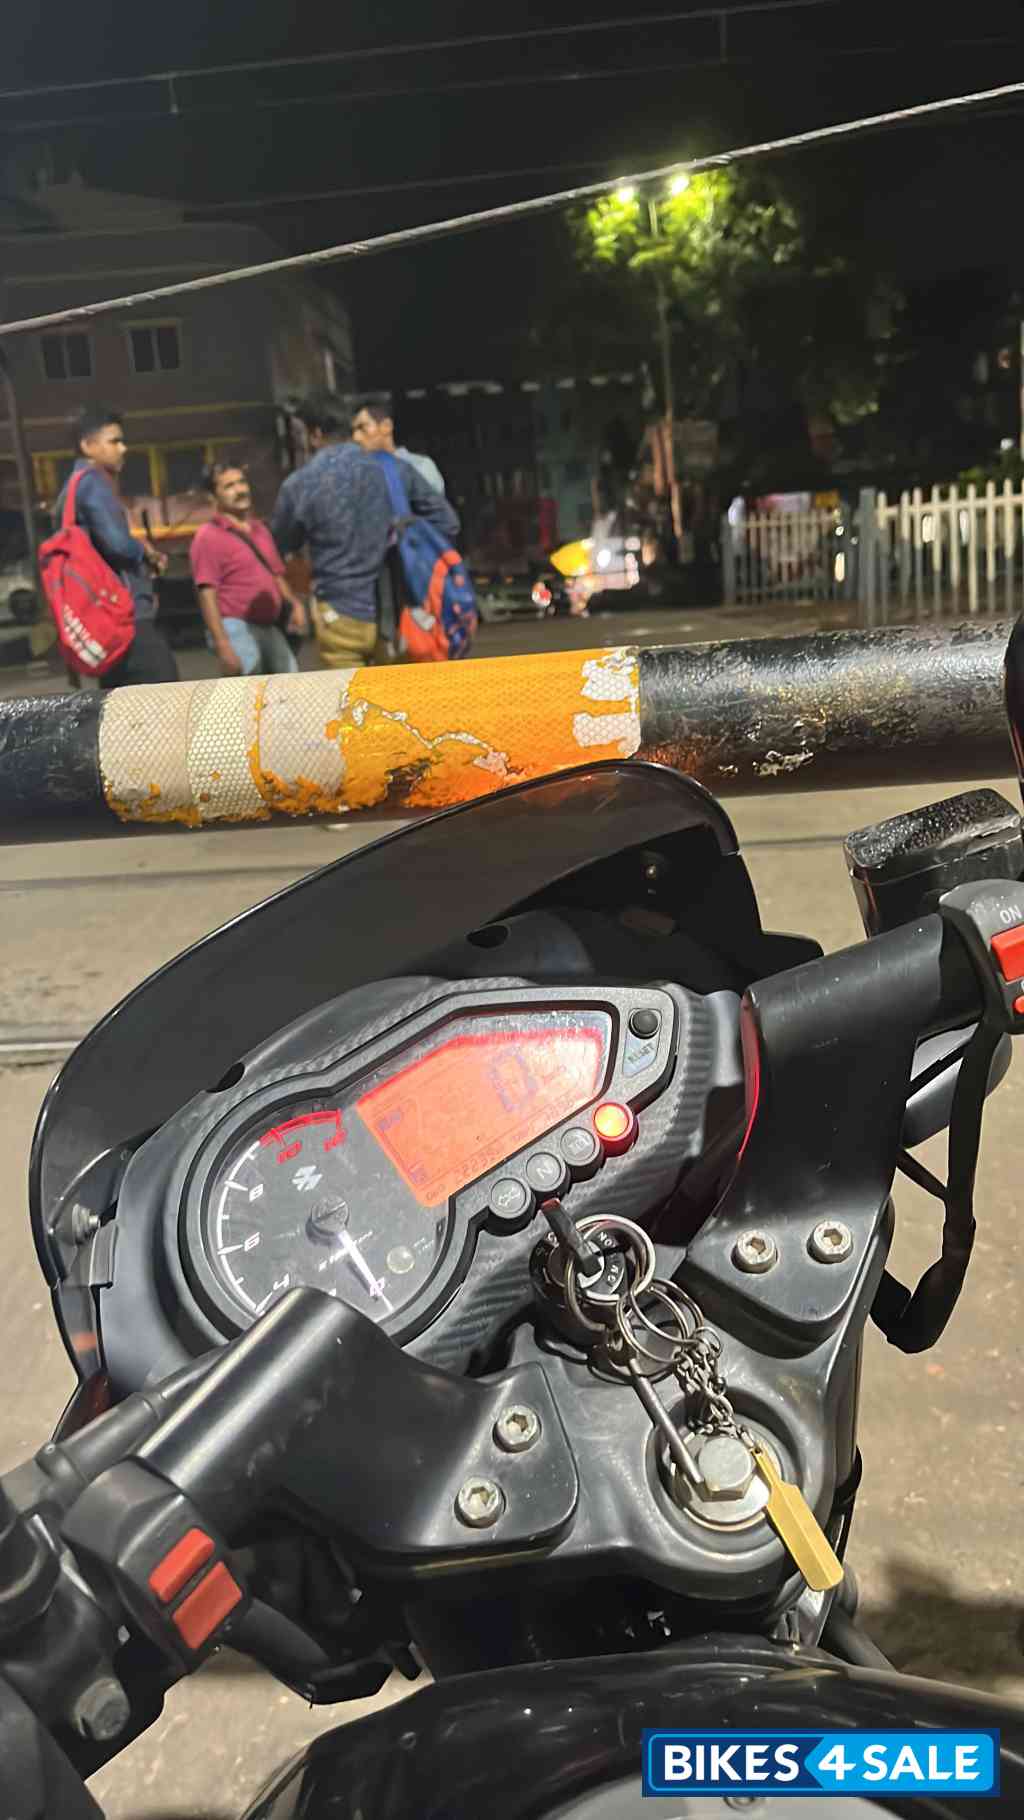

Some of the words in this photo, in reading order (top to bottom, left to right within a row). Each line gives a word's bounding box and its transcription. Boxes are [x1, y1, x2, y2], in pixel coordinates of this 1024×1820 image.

[1000, 905, 1022, 924] ON
[249, 1183, 264, 1202] 8
[244, 1231, 261, 1252] 6
[272, 1272, 290, 1291] 4
